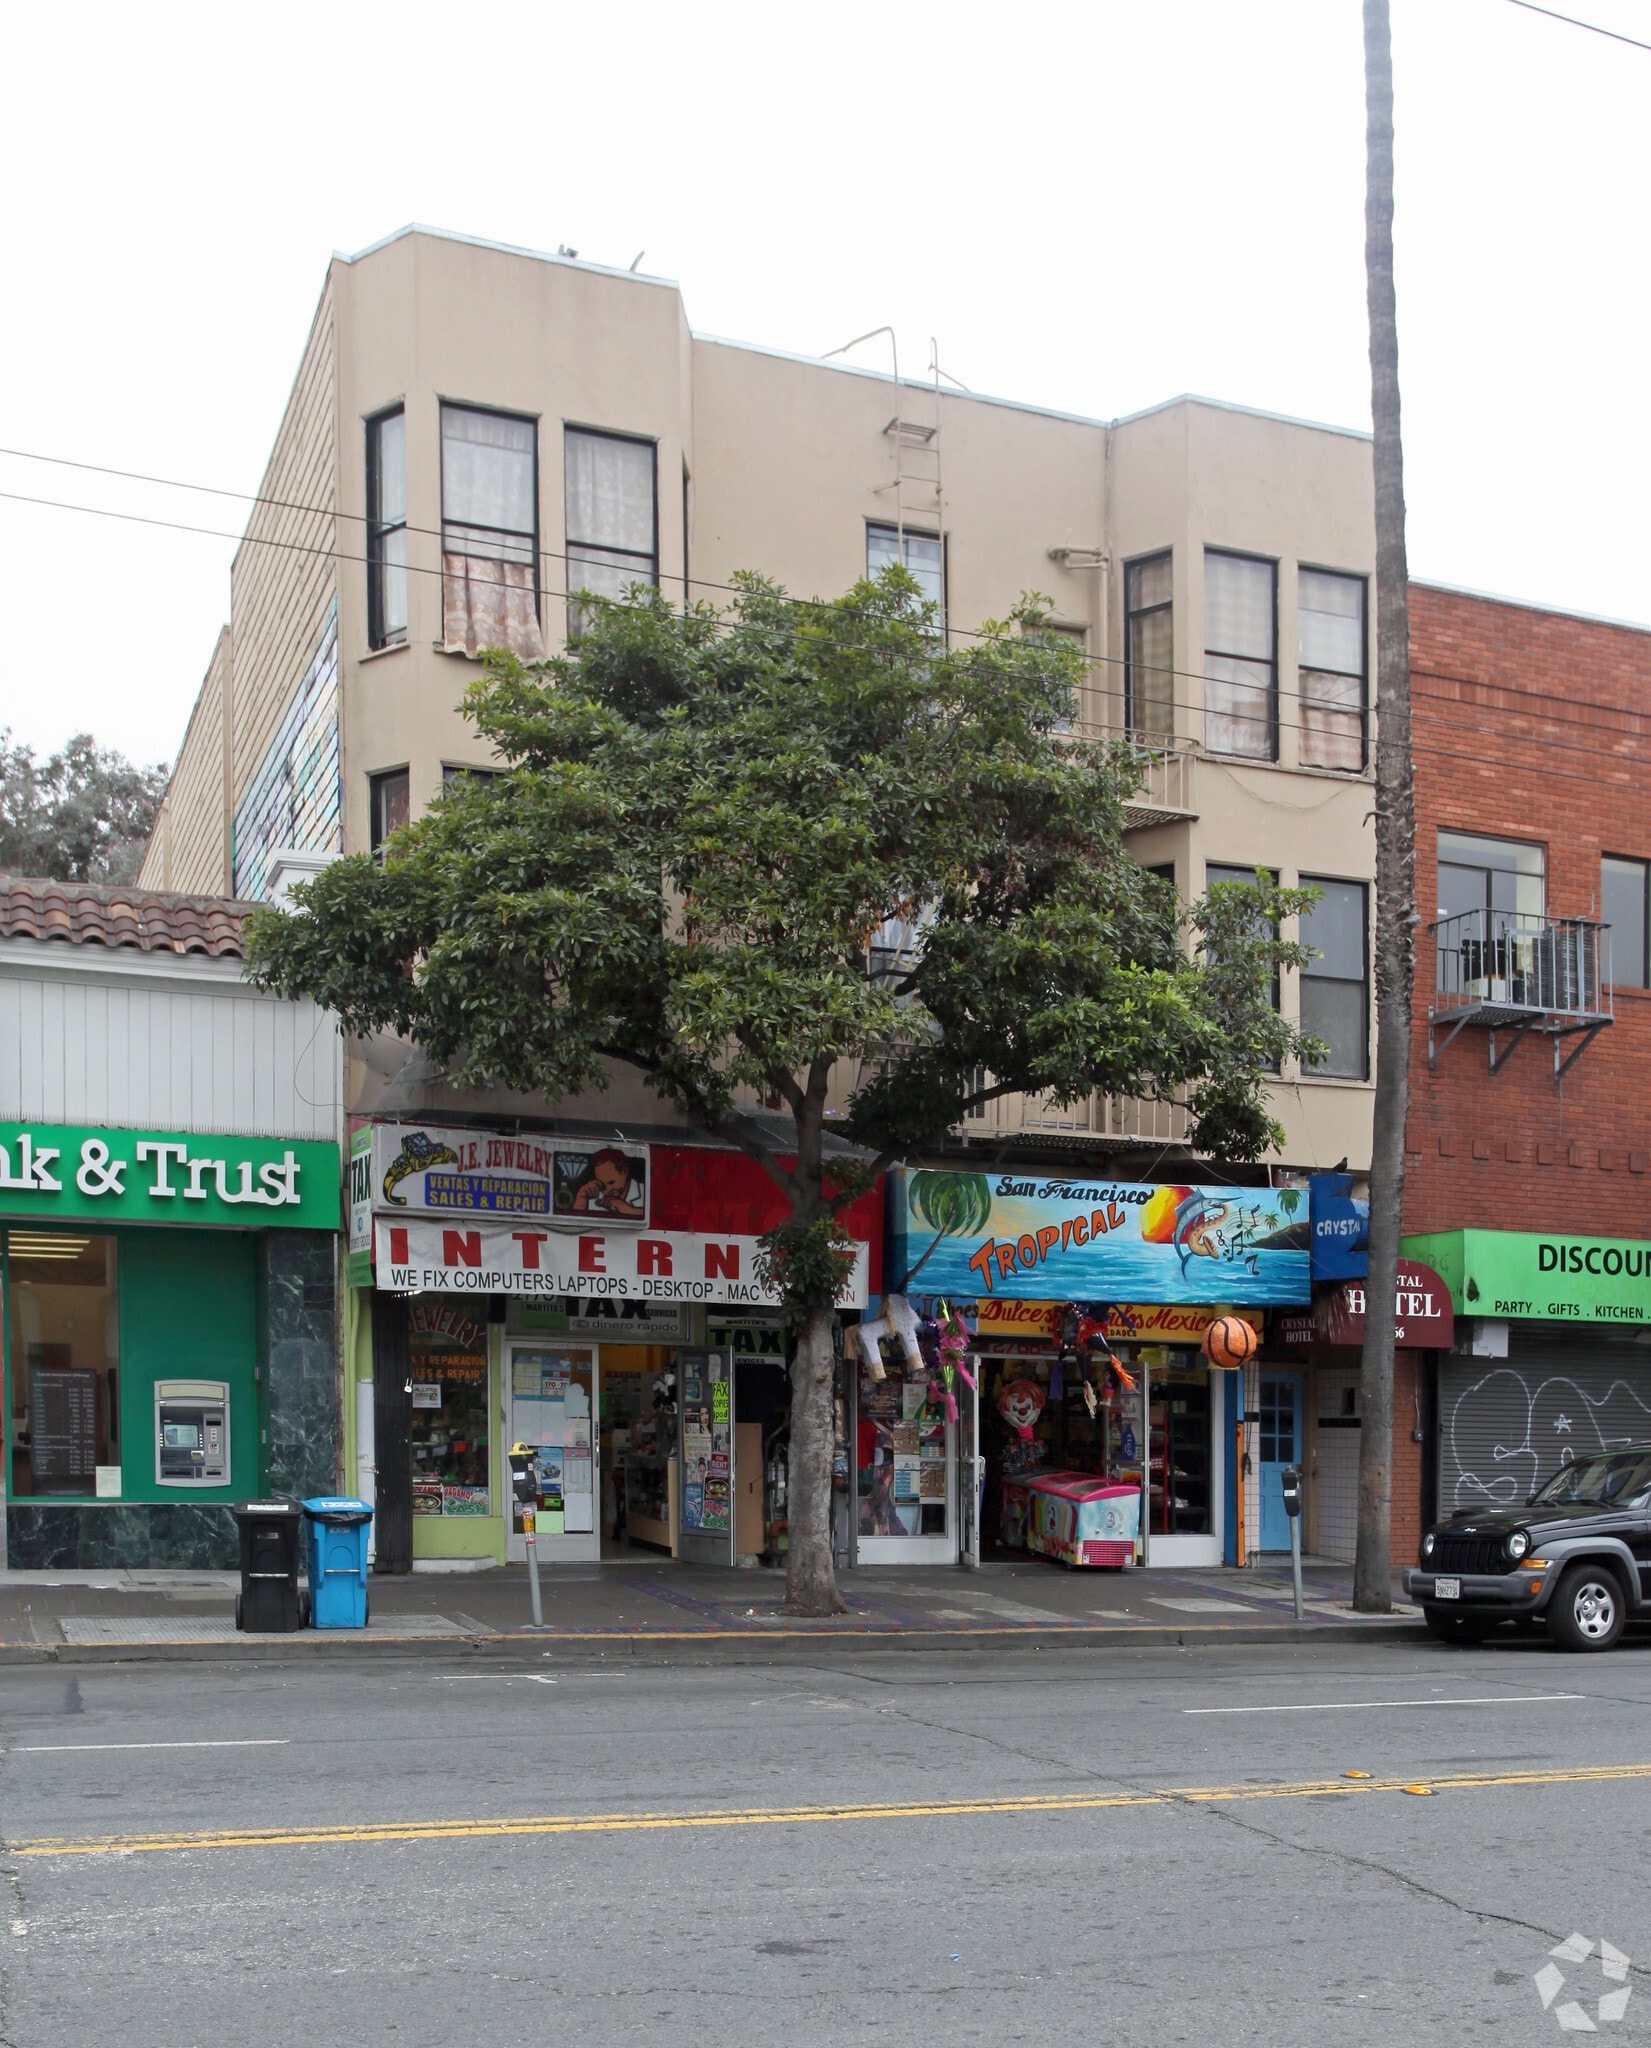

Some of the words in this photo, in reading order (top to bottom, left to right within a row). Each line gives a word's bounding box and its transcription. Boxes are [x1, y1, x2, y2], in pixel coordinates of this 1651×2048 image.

[457, 1141, 481, 1173] J.E.
[485, 1139, 552, 1179] JEWELRY
[76, 1138, 127, 1196] &
[136, 1141, 301, 1206] Trust
[352, 1153, 371, 1205] TAX
[429, 1175, 470, 1192] VENTAS
[473, 1178, 480, 1192] Y
[482, 1179, 546, 1197] REPARACION
[995, 1176, 1036, 1198] San
[1038, 1179, 1154, 1205] Francisco
[429, 1190, 474, 1207] SALES
[480, 1195, 489, 1208] &
[496, 1195, 546, 1212] REPAIR
[1316, 1219, 1361, 1237] CRYSTAL
[969, 1202, 1125, 1292] TROPICAL
[391, 1268, 418, 1288] WE
[424, 1270, 449, 1288] FIX
[454, 1271, 554, 1291] COMPUTERS
[558, 1275, 628, 1295] LAPTOPS
[643, 1279, 714, 1298] DESKTOP
[727, 1284, 760, 1301] MAC
[526, 1303, 564, 1313] MARTITA'S
[646, 1309, 678, 1318] SERVICES
[980, 1299, 1055, 1323] Dulces
[1348, 1290, 1441, 1318] HTEL
[1495, 1300, 1532, 1314] PARTY
[1547, 1303, 1580, 1316] GIFTS
[1595, 1306, 1643, 1319] KITCHEN
[592, 1320, 633, 1331] dinero
[1281, 1317, 1317, 1330] CRYSTAL
[709, 1328, 783, 1353] TAX
[1286, 1331, 1313, 1343] HOTEL
[447, 1369, 481, 1379] REPAIR
[713, 1383, 728, 1397] FAX
[711, 1461, 728, 1470] RENT
[446, 1503, 487, 1514] CASH
